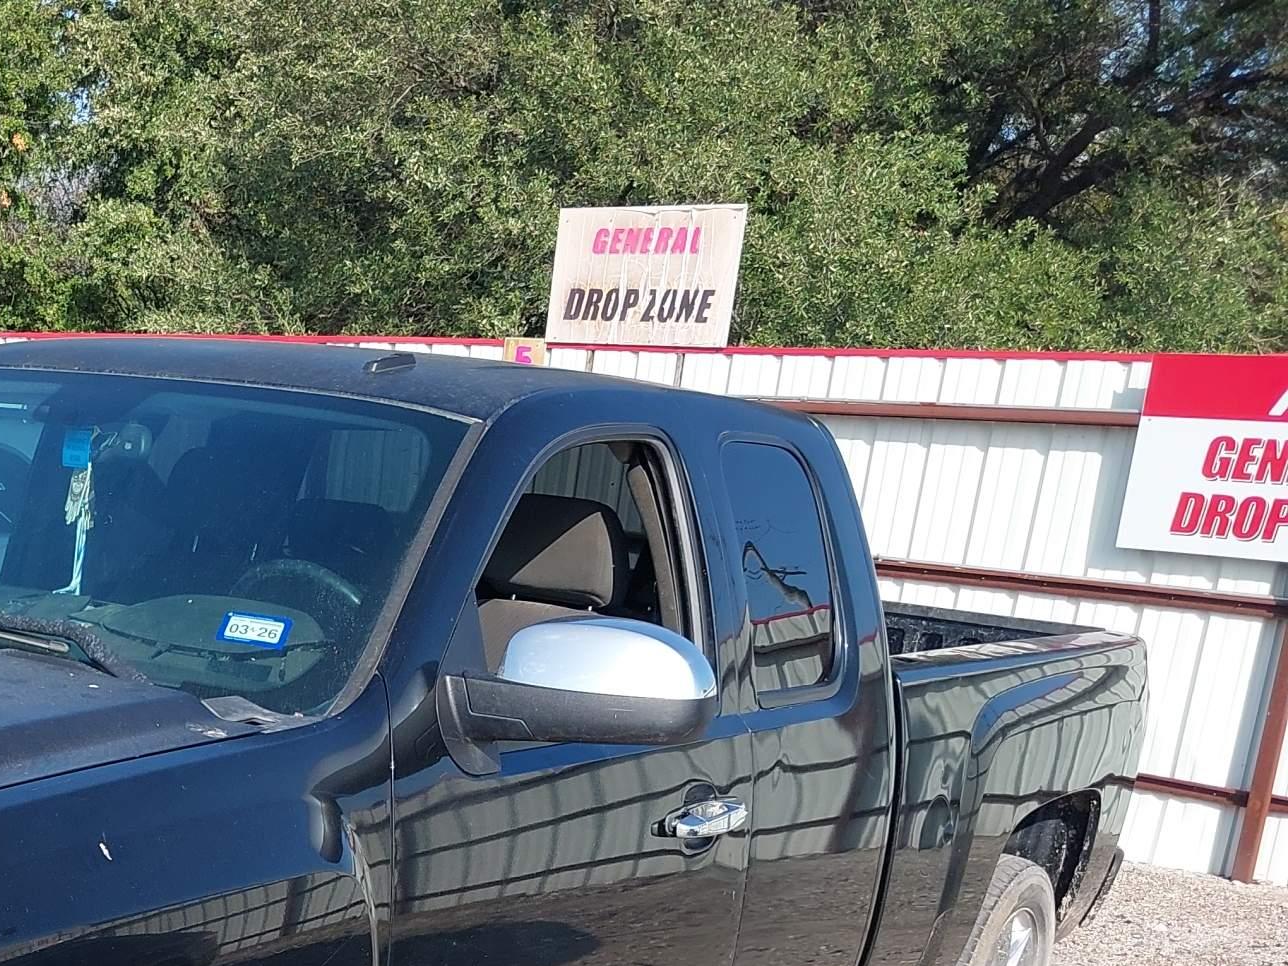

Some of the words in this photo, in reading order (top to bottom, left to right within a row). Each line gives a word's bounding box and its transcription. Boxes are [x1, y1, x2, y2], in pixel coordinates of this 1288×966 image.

[591, 226, 701, 256] GENERAL
[562, 287, 640, 322] DROP
[640, 289, 715, 324] ZONE
[1201, 435, 1288, 484] GEN
[1169, 491, 1288, 543] DROP
